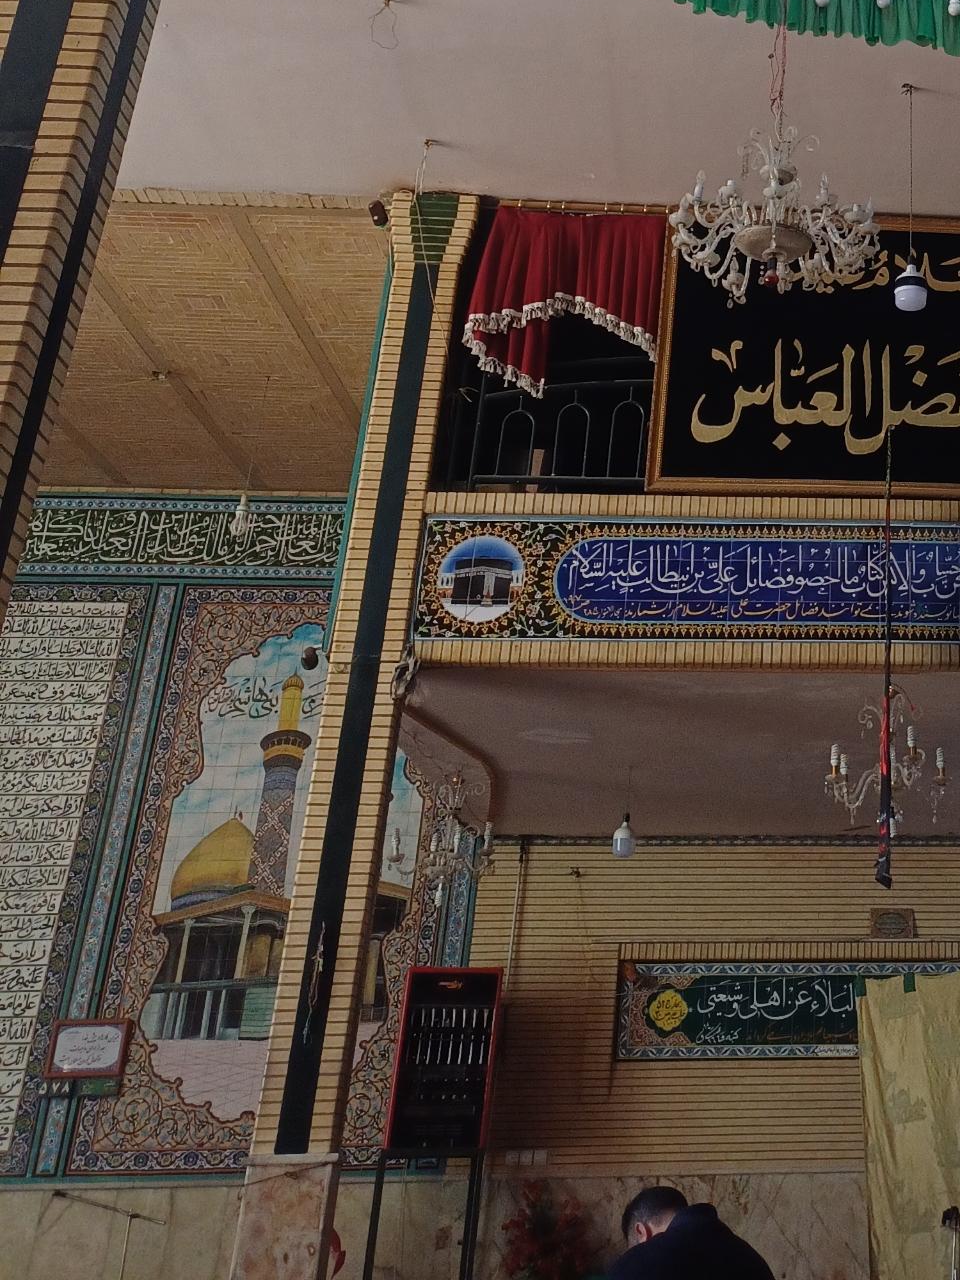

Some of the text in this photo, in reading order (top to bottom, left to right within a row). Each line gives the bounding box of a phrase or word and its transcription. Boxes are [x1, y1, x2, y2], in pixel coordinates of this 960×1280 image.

[690, 337, 873, 451] العباس
[731, 597, 749, 619] علی
[743, 600, 792, 620] حضرت
